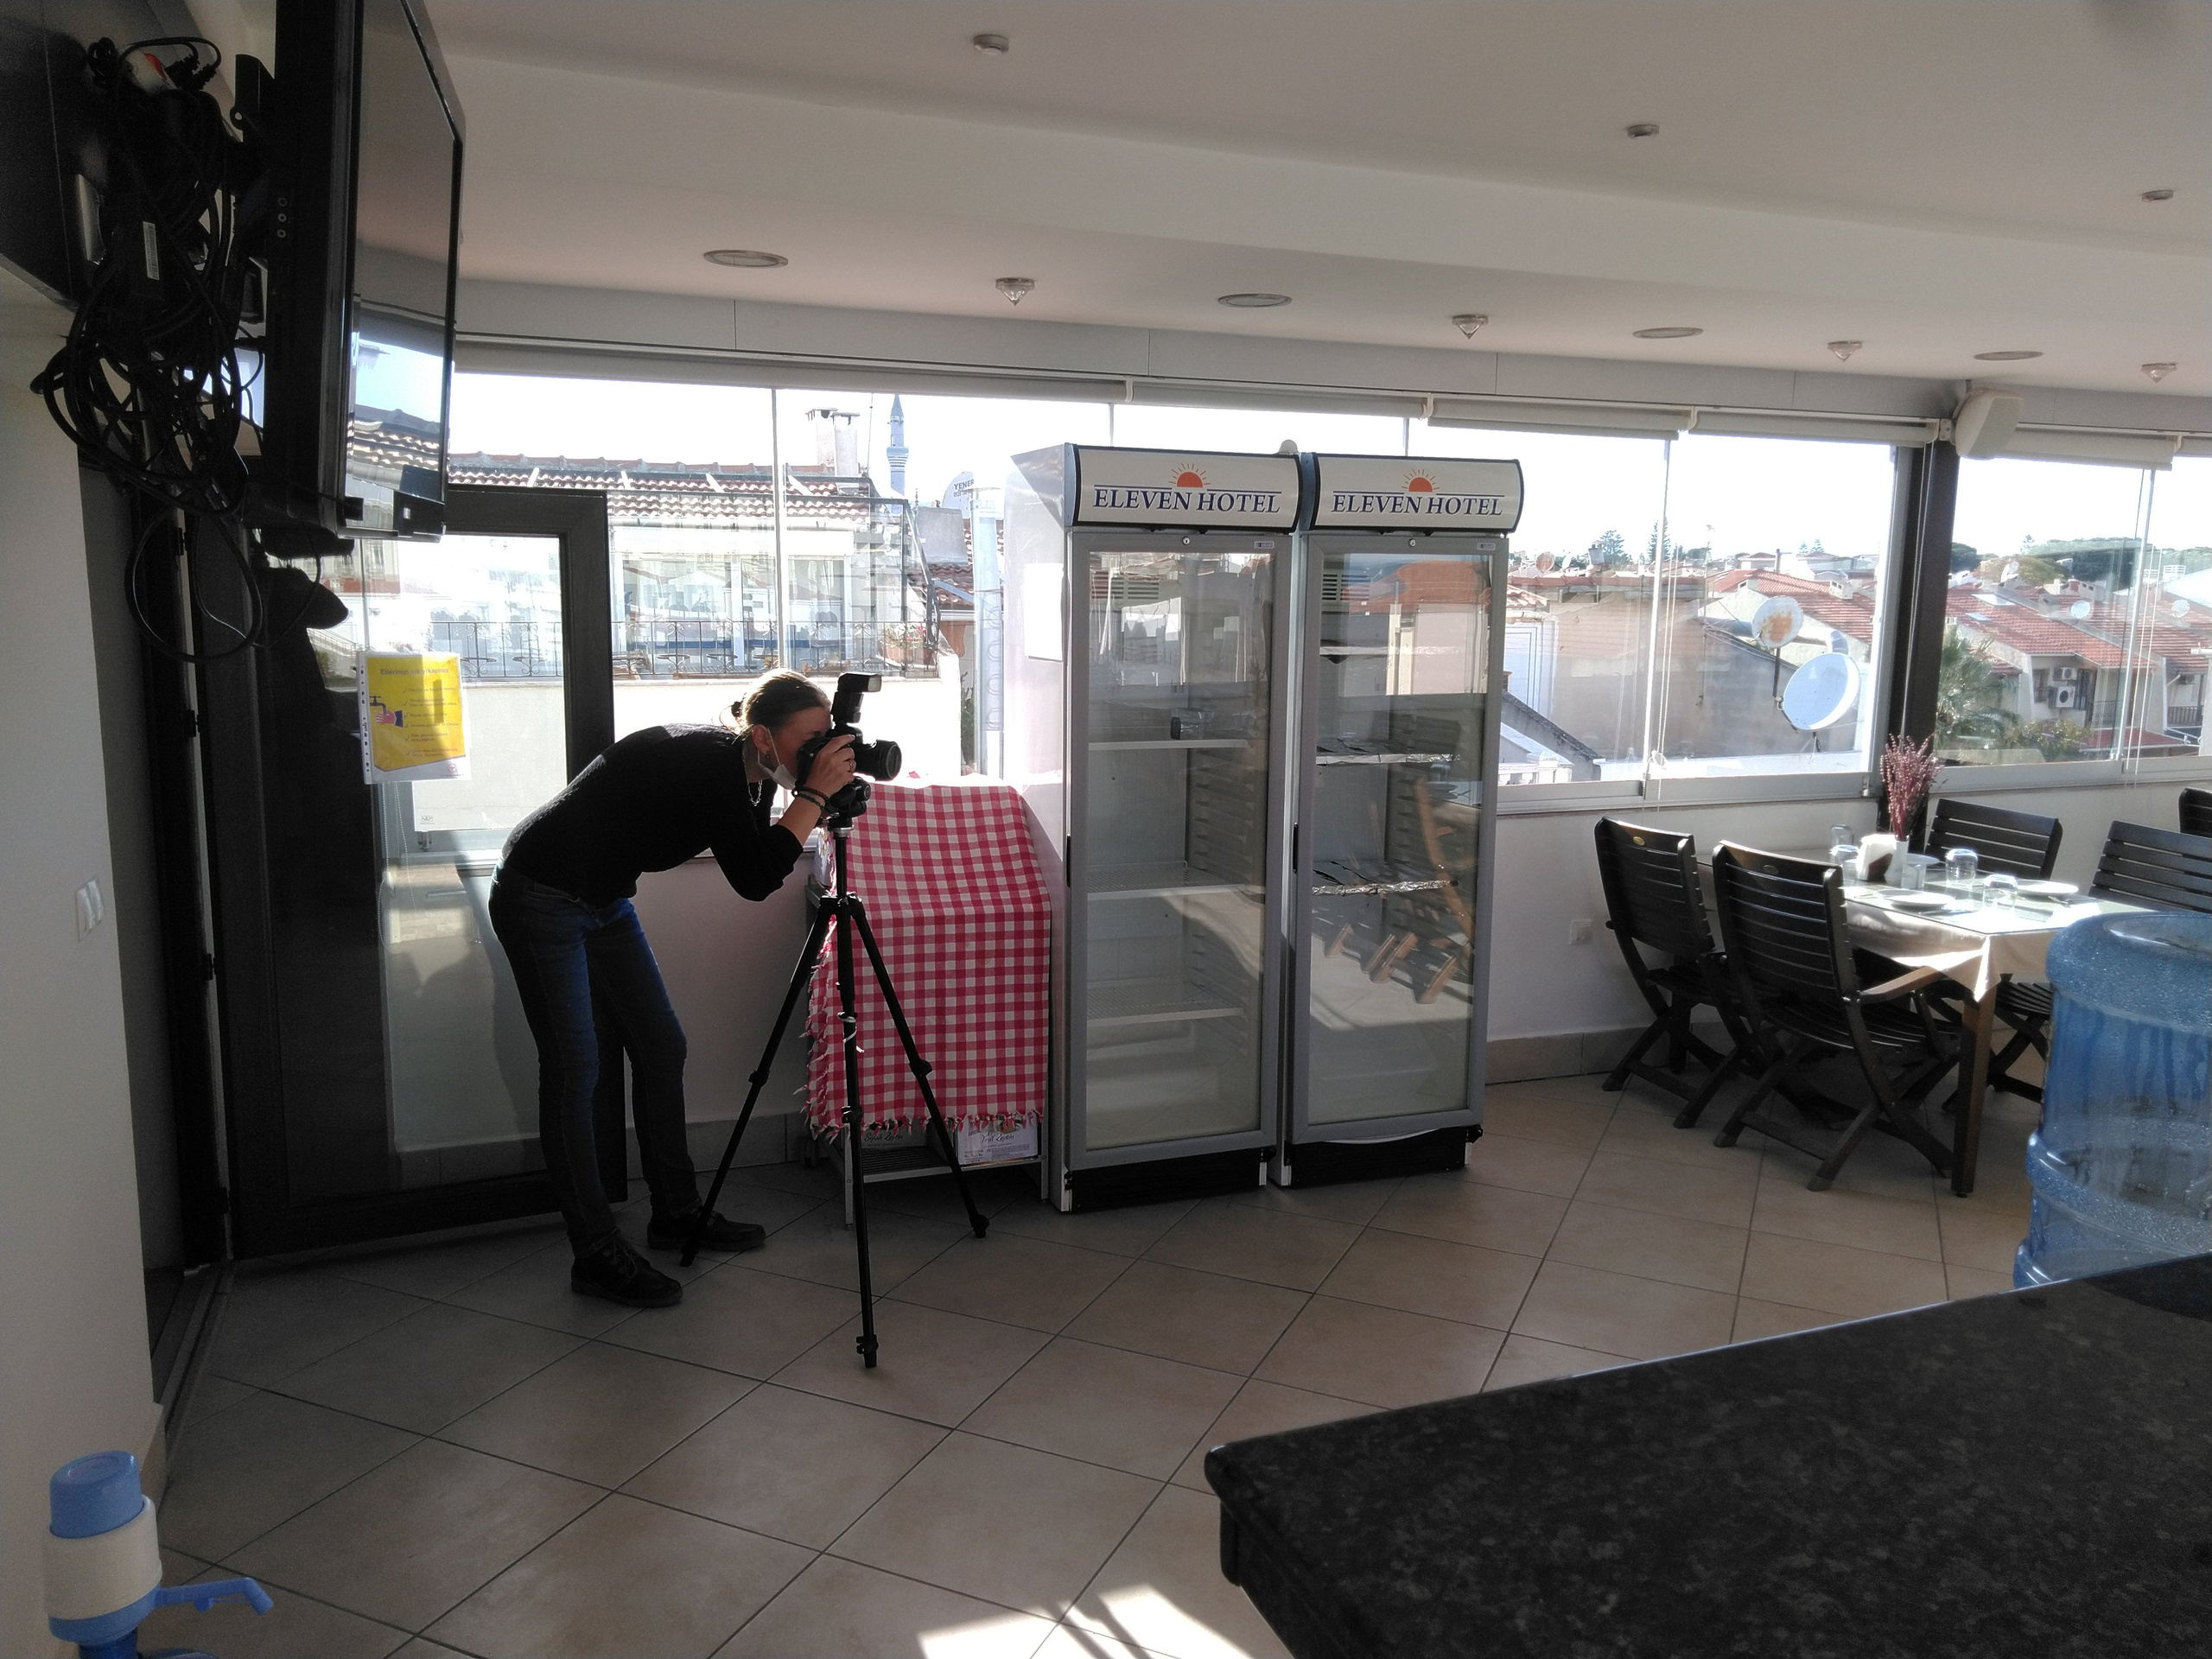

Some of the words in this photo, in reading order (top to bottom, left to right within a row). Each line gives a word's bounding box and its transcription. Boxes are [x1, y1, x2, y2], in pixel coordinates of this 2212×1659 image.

[953, 479, 975, 490] YENER
[1092, 488, 1193, 511] ELEVEN
[1196, 492, 1281, 513] HOTEL
[1331, 493, 1423, 514] ELEVEN
[1425, 496, 1503, 517] HOTEL
